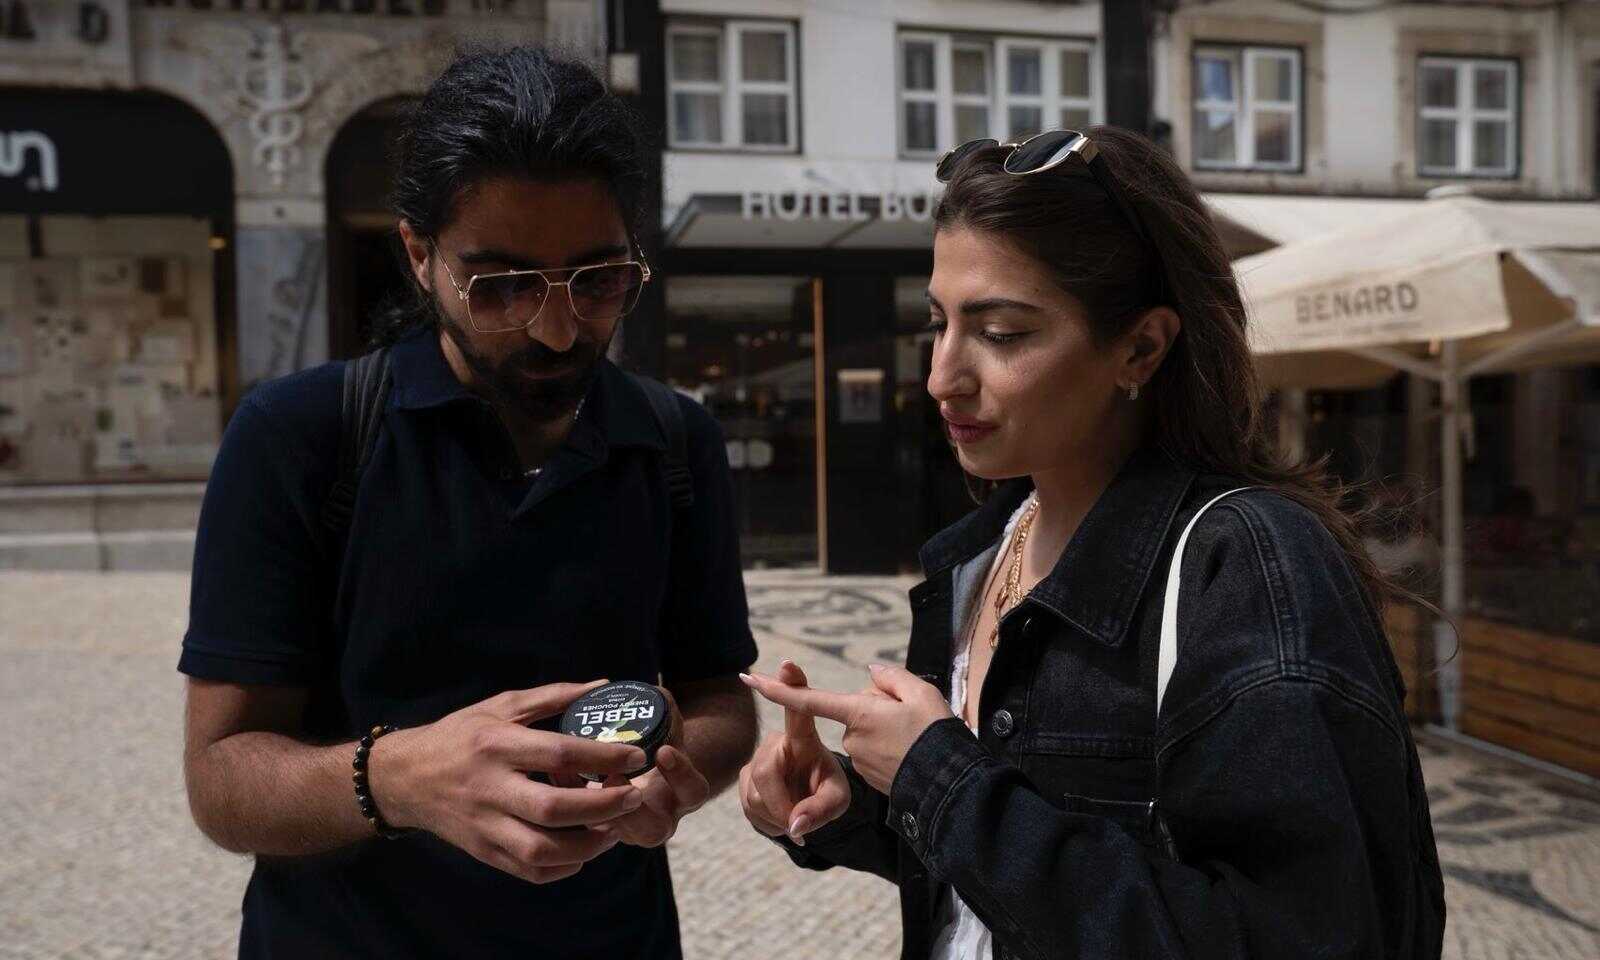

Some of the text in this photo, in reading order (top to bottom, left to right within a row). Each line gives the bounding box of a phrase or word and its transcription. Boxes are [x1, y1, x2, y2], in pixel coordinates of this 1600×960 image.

[742, 190, 873, 221] HOTEL
[1296, 282, 1419, 323] BENARD
[575, 705, 655, 725] REBEL
[583, 703, 618, 711] POUCHES
